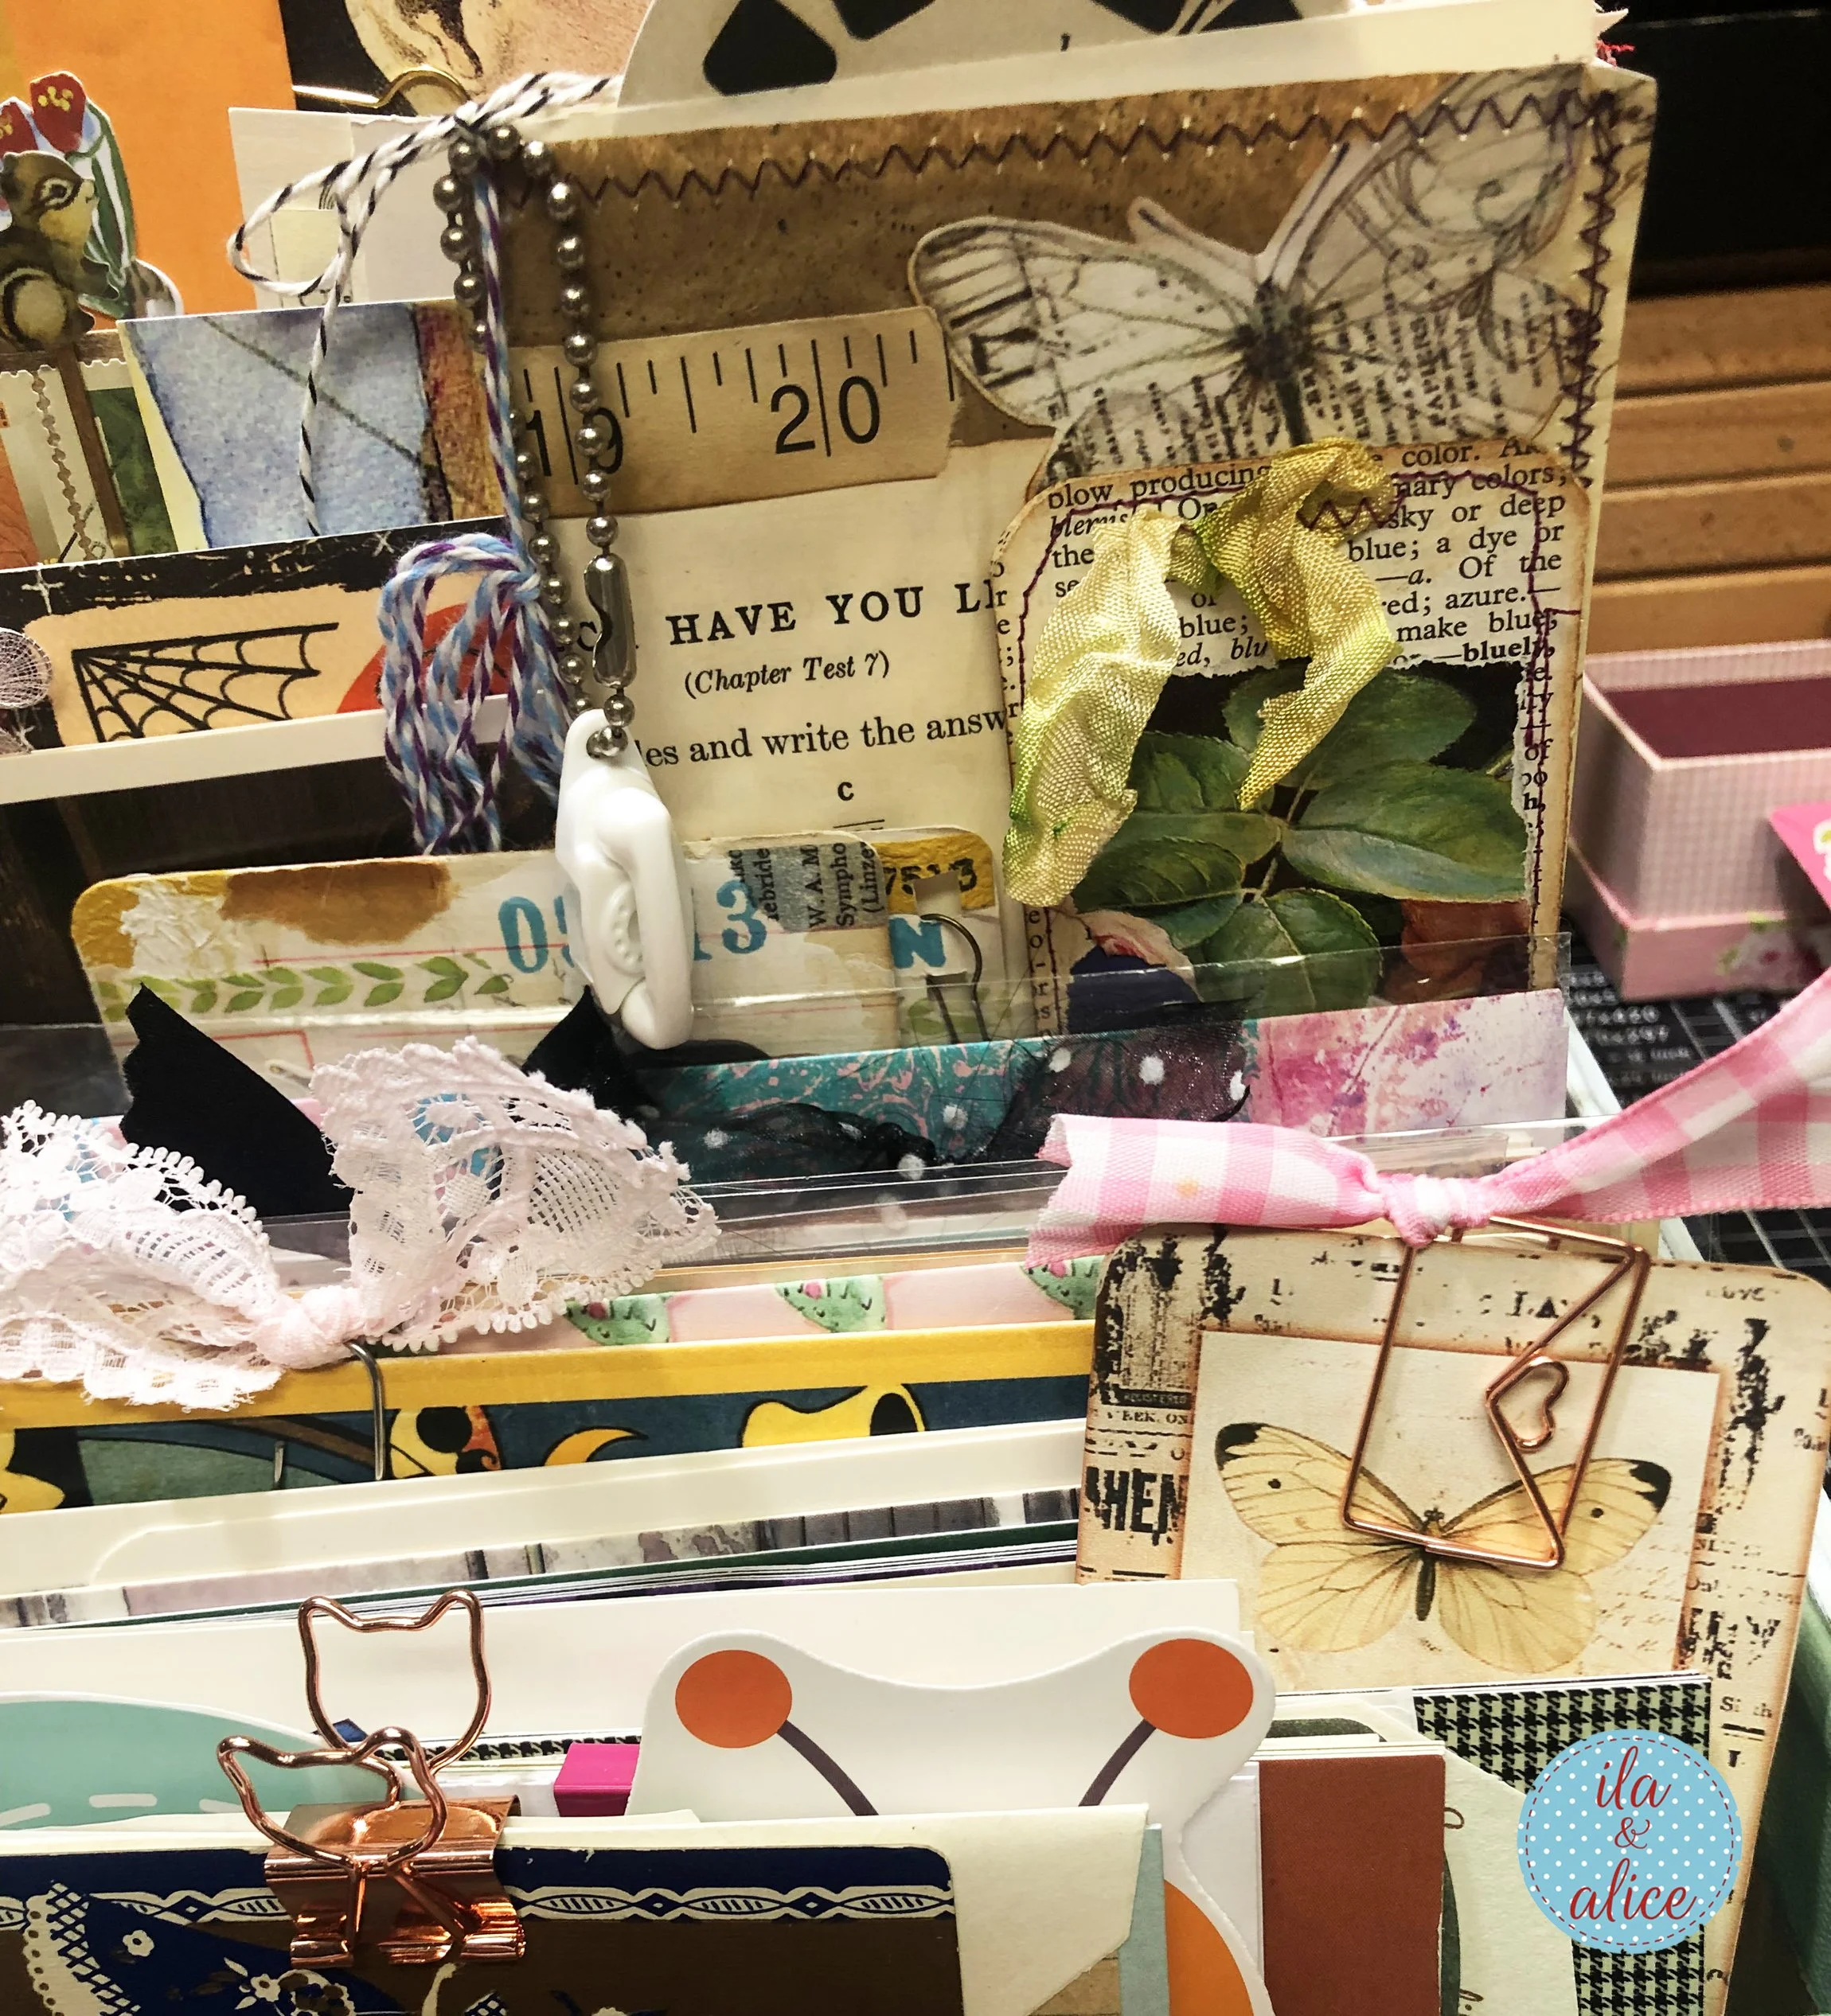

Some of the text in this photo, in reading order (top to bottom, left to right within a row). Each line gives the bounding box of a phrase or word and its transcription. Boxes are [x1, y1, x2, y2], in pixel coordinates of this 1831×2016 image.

[770, 375, 880, 455] 20
[1401, 444, 1480, 468] color.
[1451, 503, 1482, 523] or
[1500, 492, 1565, 518] deep
[1346, 538, 1419, 562] blue;
[1436, 537, 1451, 554] a
[1469, 526, 1517, 554] dye
[1458, 554, 1497, 579] Of
[1519, 552, 1563, 573] the
[666, 602, 796, 645] HAVE
[826, 586, 923, 625] YOU
[1179, 614, 1248, 638] blue;
[1381, 591, 1431, 617] ed;
[1396, 616, 1468, 642] make
[685, 649, 890, 700] (Chapter Test 7)
[689, 728, 752, 762] and
[762, 723, 849, 755] write
[860, 716, 916, 747] the
[831, 842, 854, 926] Sympho
